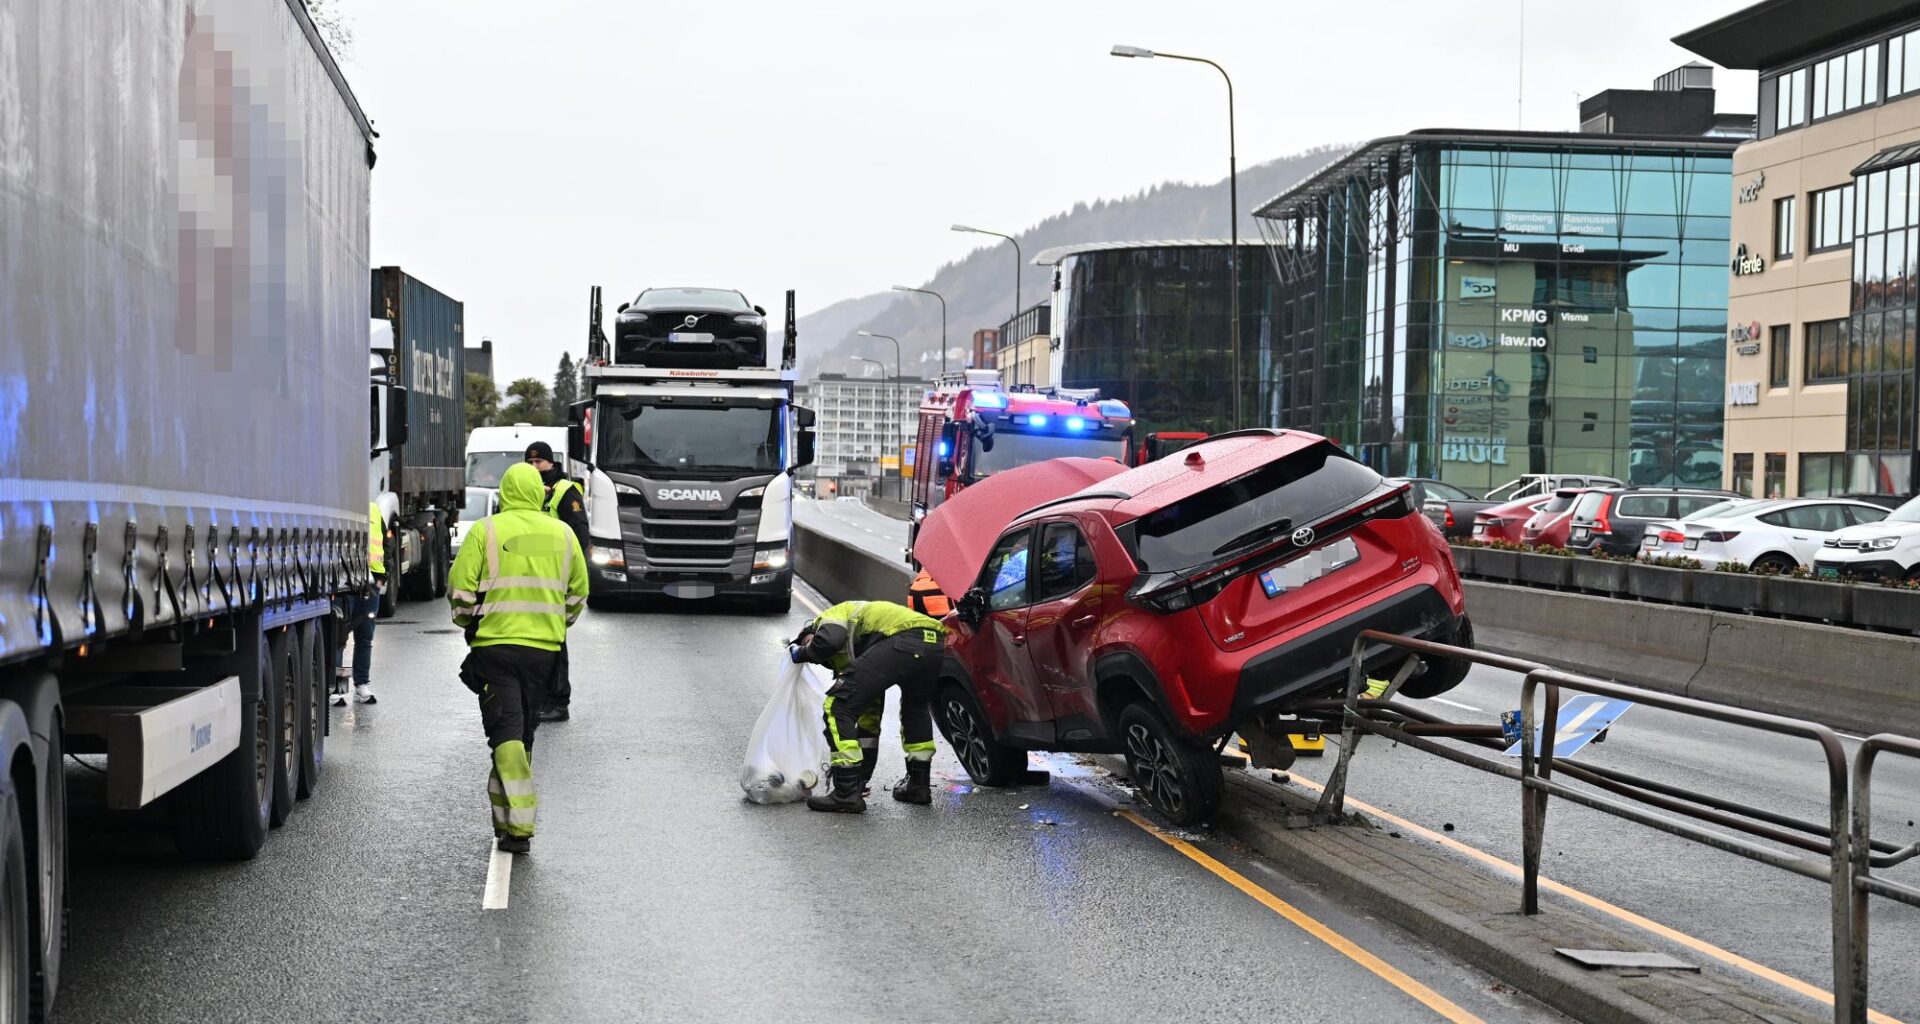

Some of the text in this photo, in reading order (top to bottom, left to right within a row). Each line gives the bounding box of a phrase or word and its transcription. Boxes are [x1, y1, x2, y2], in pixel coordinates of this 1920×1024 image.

[1562, 214, 1617, 224] Rasmussen
[1504, 222, 1544, 233] Gruppen
[1503, 243, 1519, 252] MU
[1740, 253, 1763, 274] Ferde
[1501, 308, 1547, 323] KPMG
[1560, 312, 1589, 322] Visma
[1500, 333, 1546, 347] law.no
[657, 488, 722, 501] SCANIA
